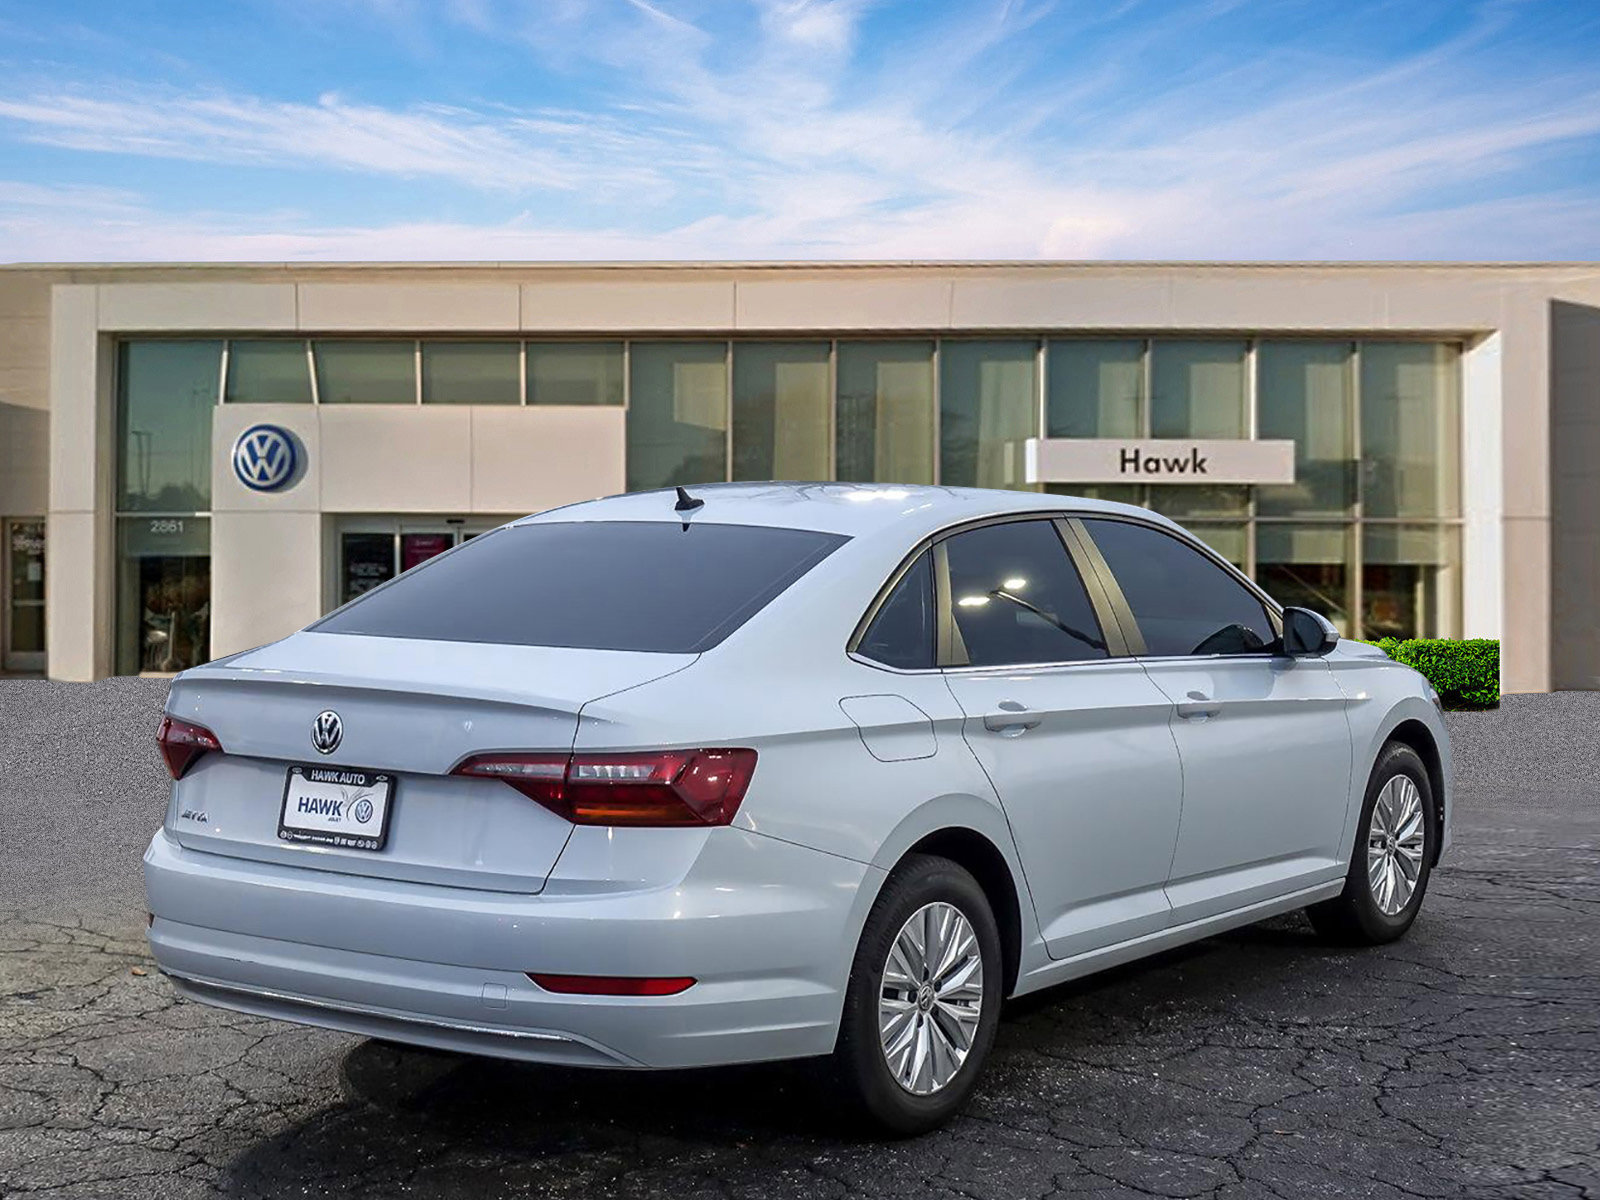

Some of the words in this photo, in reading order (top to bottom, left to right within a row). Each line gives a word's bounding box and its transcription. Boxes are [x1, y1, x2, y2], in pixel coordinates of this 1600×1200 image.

[1120, 447, 1207, 474] Hawk
[310, 769, 339, 783] HAWK
[339, 773, 365, 785] AUTO
[297, 796, 344, 817] HAWK
